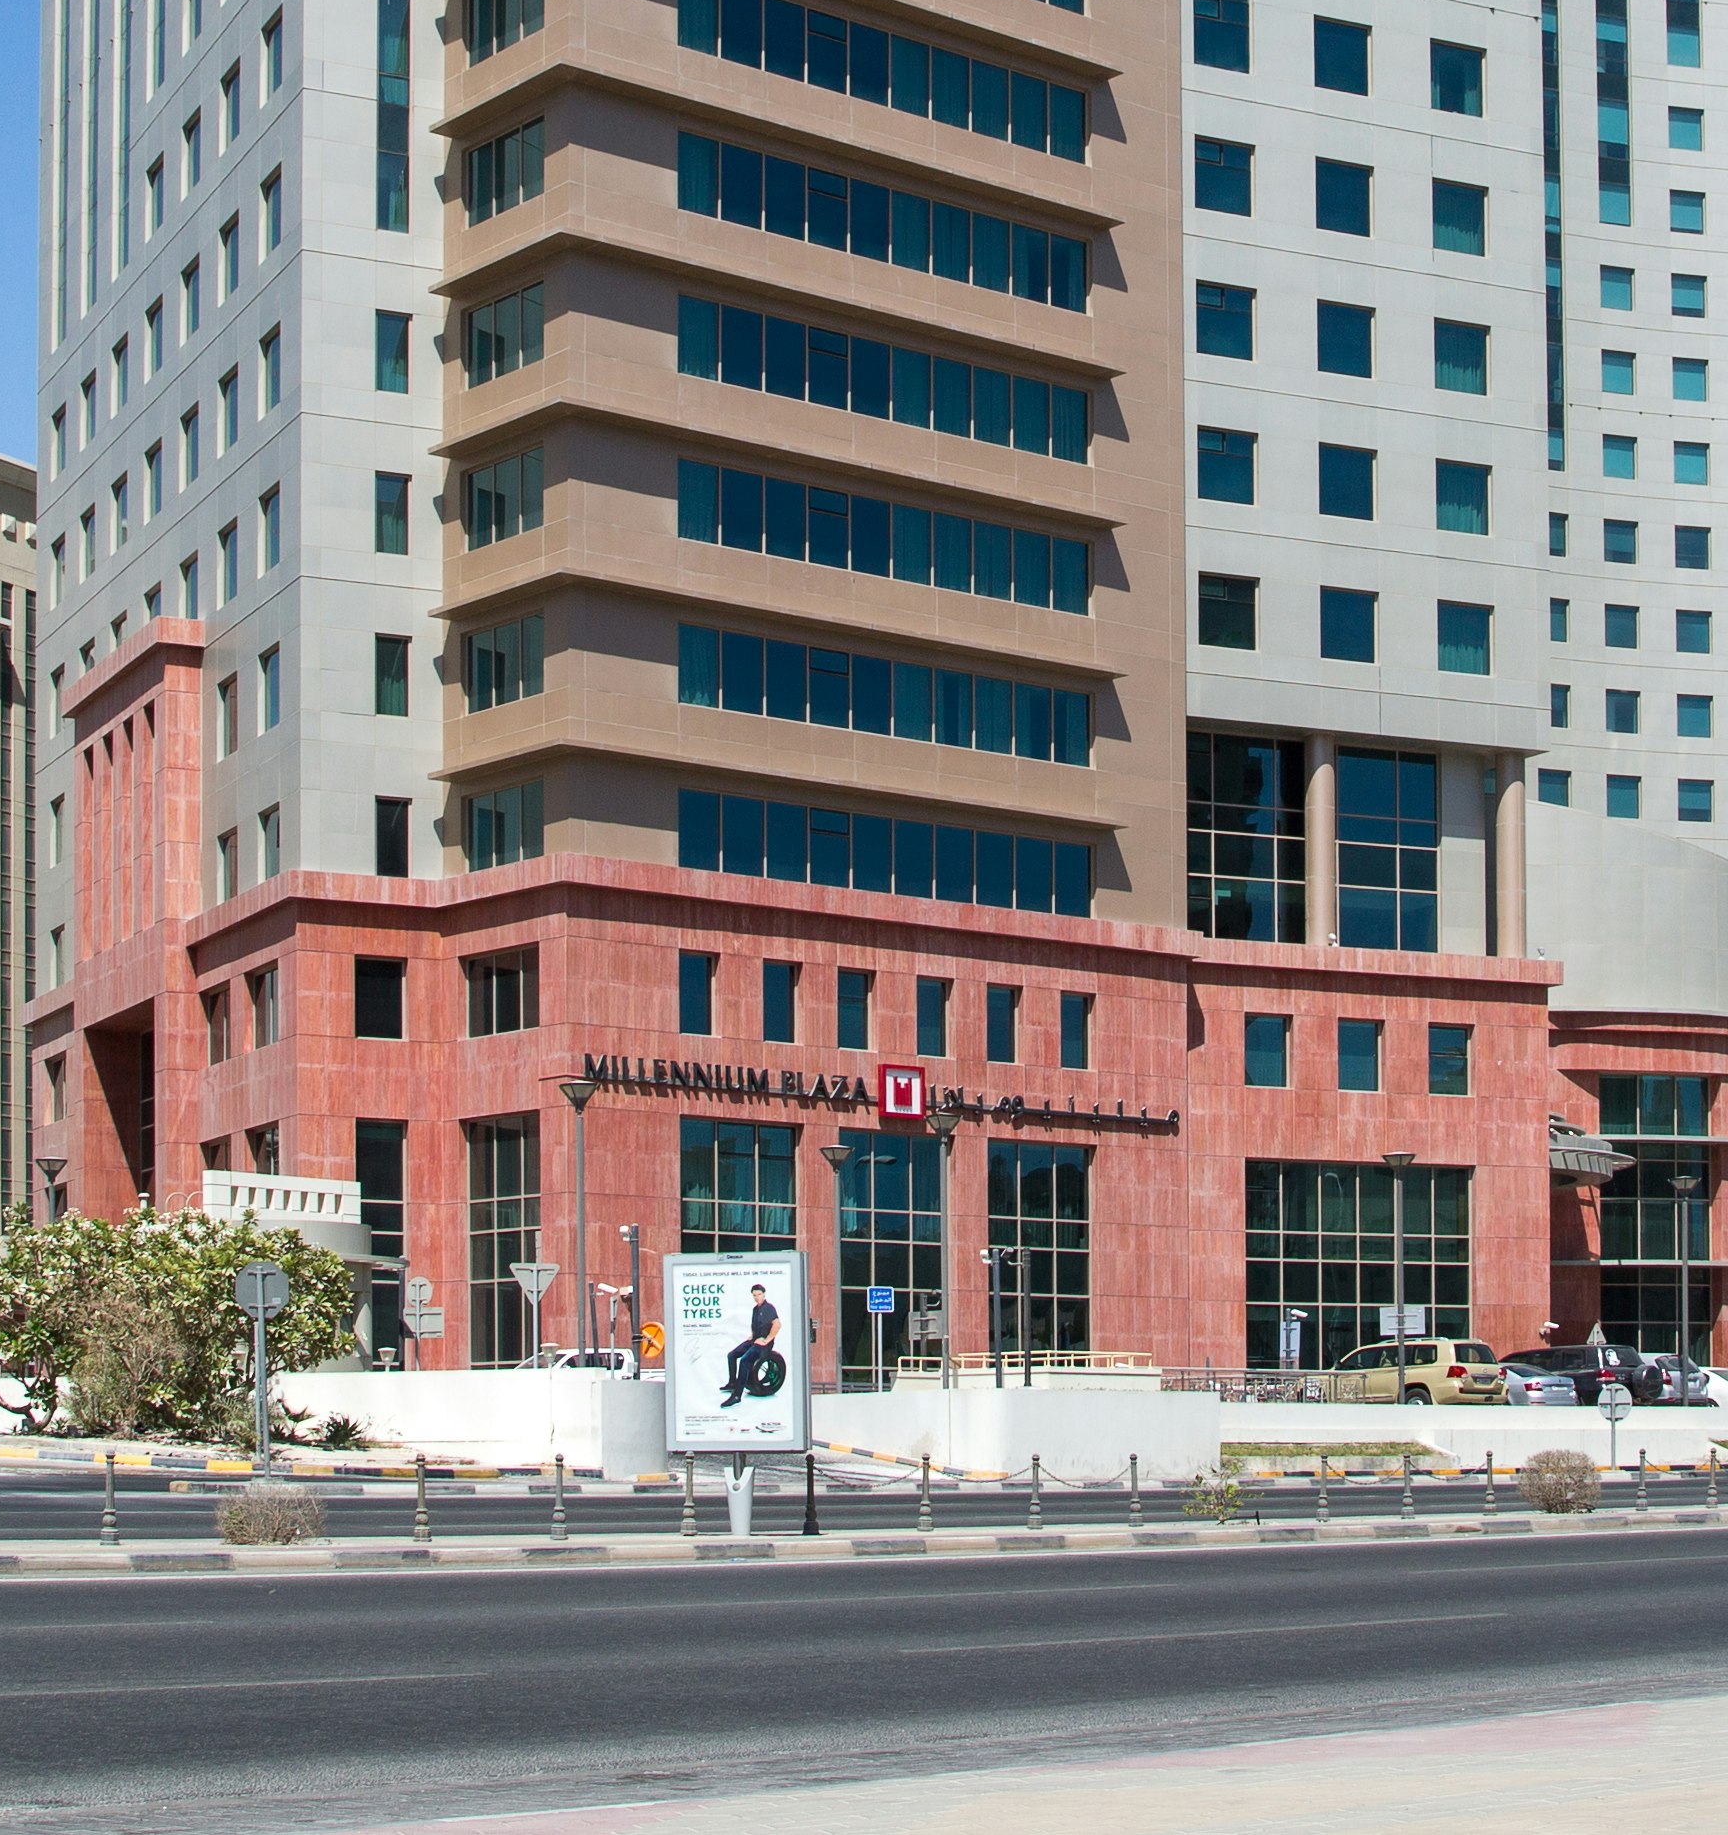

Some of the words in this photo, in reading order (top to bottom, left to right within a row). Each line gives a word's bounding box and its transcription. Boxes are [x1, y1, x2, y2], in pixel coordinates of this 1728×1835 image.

[584, 1052, 769, 1094] MILLENNIUM
[780, 1069, 873, 1102] PLAZA
[682, 1284, 725, 1295] CHECK
[683, 1296, 721, 1307] YOUR
[683, 1308, 722, 1319] TYRES
